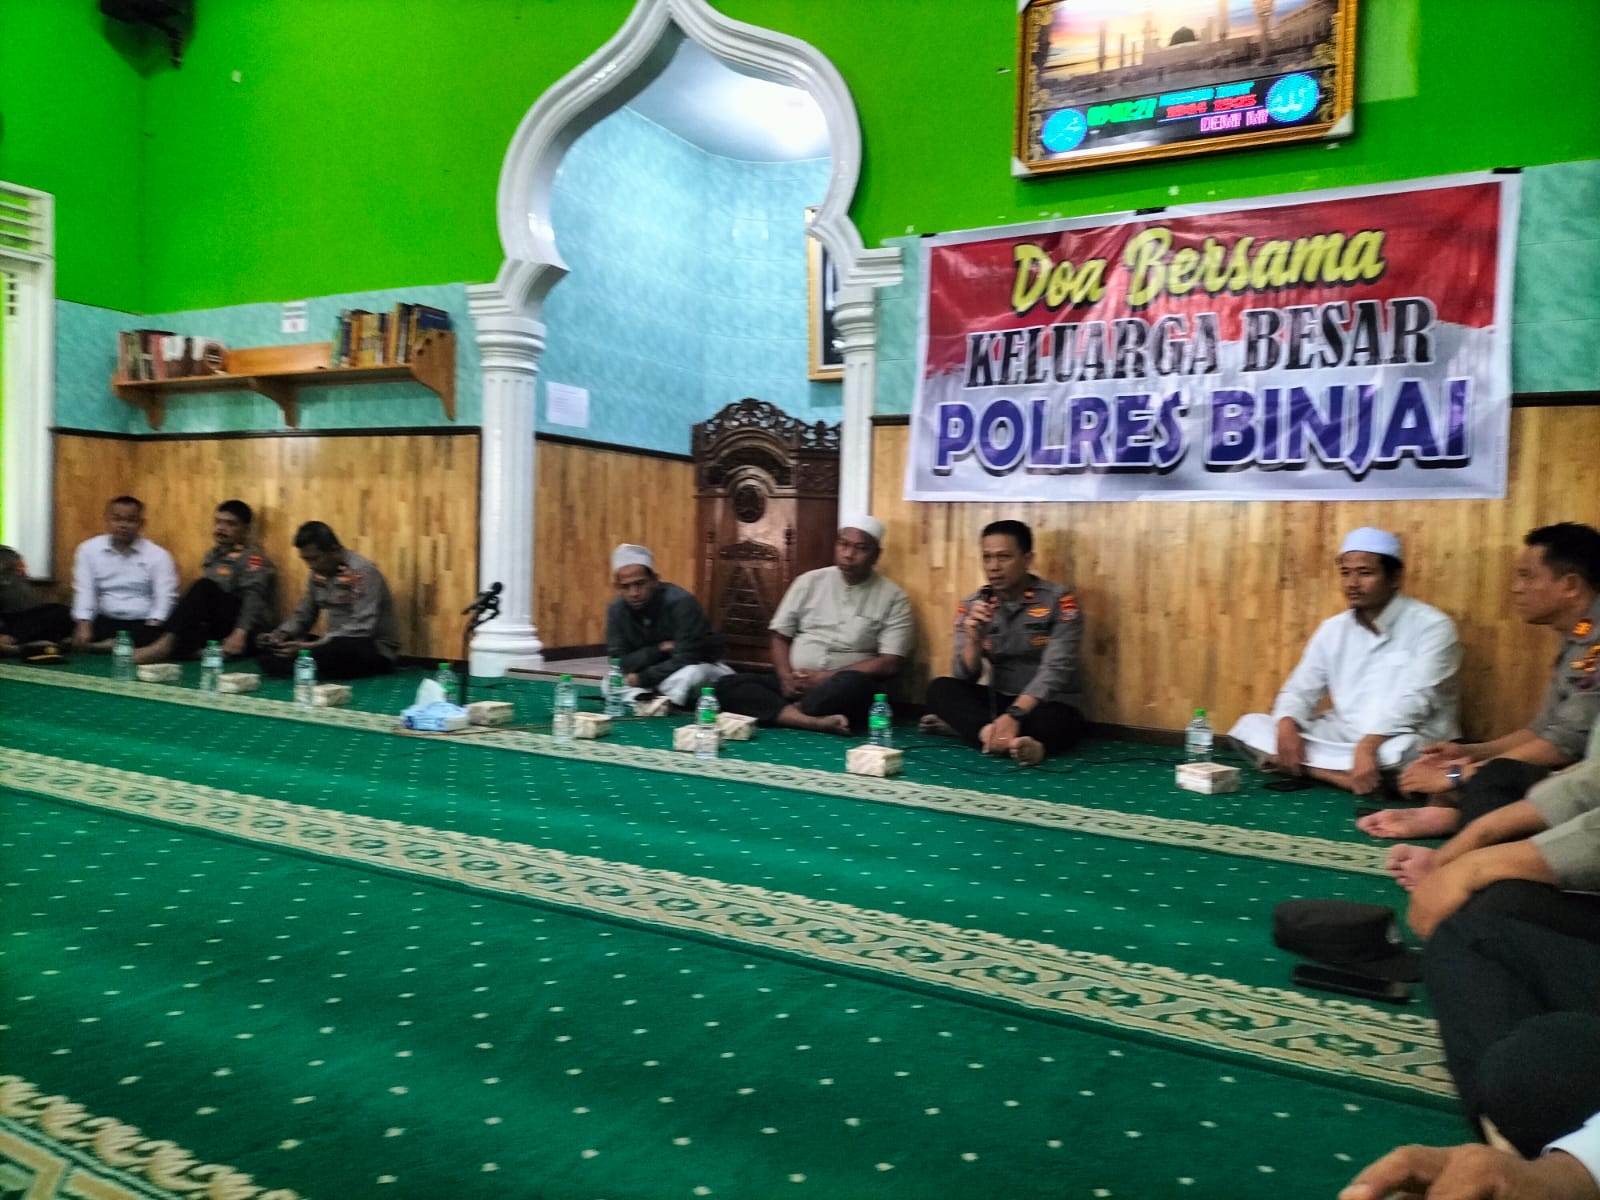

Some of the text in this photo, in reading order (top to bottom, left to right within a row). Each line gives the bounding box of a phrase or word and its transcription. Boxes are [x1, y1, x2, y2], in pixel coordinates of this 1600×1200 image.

[1012, 226, 1386, 315] Doa Bersama
[965, 297, 1436, 388] KELUARGA BESAR
[933, 377, 1471, 478] POLRES BINJAI
